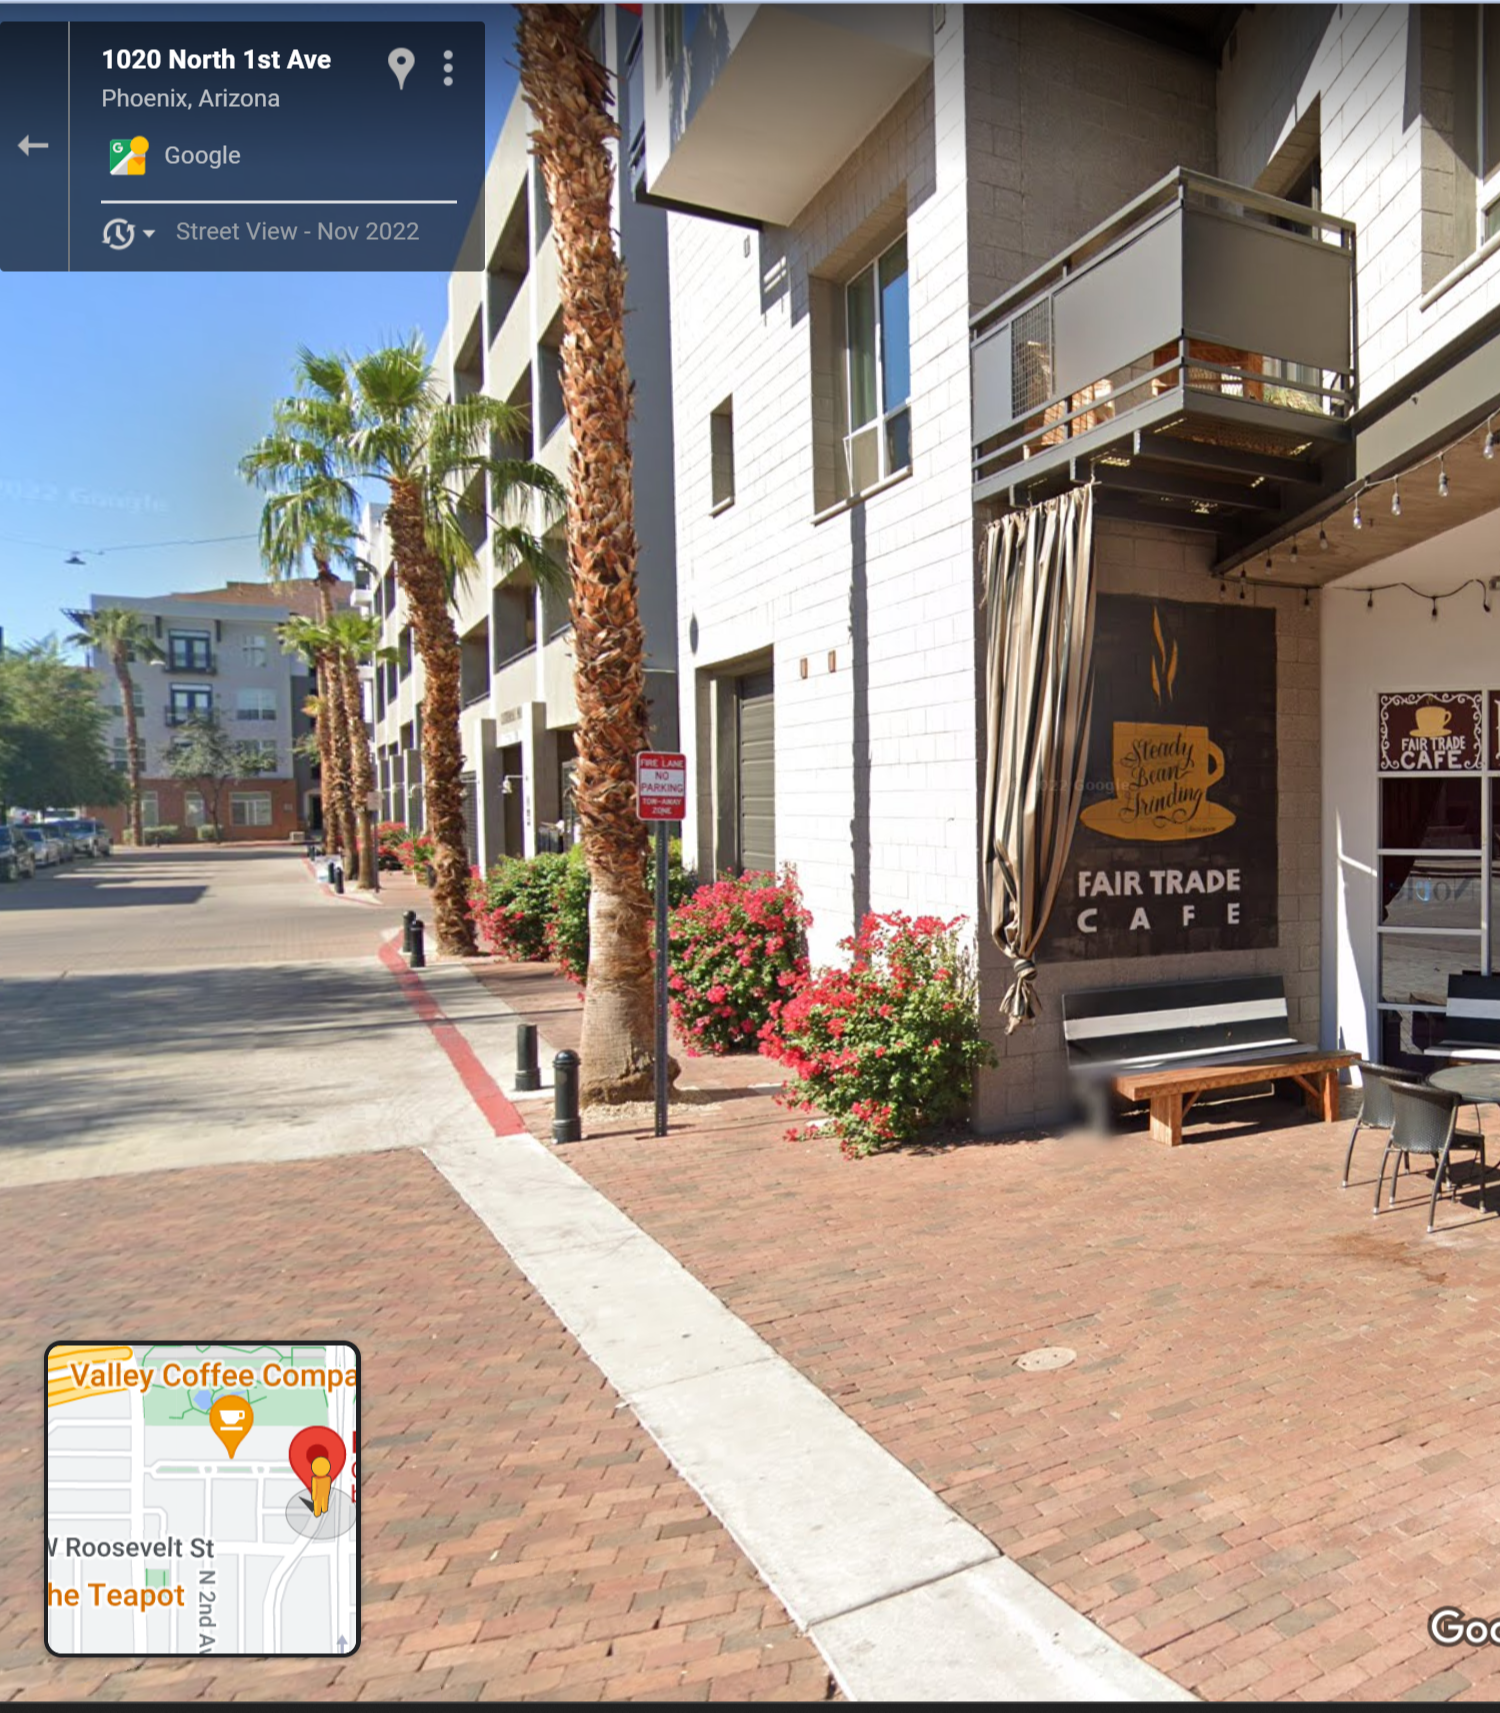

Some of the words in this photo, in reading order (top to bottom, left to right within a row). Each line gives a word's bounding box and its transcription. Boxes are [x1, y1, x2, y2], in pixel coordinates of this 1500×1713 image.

[1119, 731, 1195, 771] Steady
[1401, 736, 1427, 751] FAIR
[1429, 736, 1466, 750] TRADE
[640, 759, 658, 768] FIRE
[661, 759, 684, 768] LANE
[1400, 749, 1462, 770] CAFE
[654, 771, 669, 781] NO
[1128, 763, 1192, 792] Bean
[641, 782, 684, 793] PARKING
[642, 797, 682, 806] TOW-AWAY
[1118, 782, 1204, 829] Grinding
[651, 806, 673, 816] ZONE
[1078, 870, 1144, 898] FAIR
[1149, 868, 1241, 895] TRADE
[1076, 902, 1241, 934] CAFE
